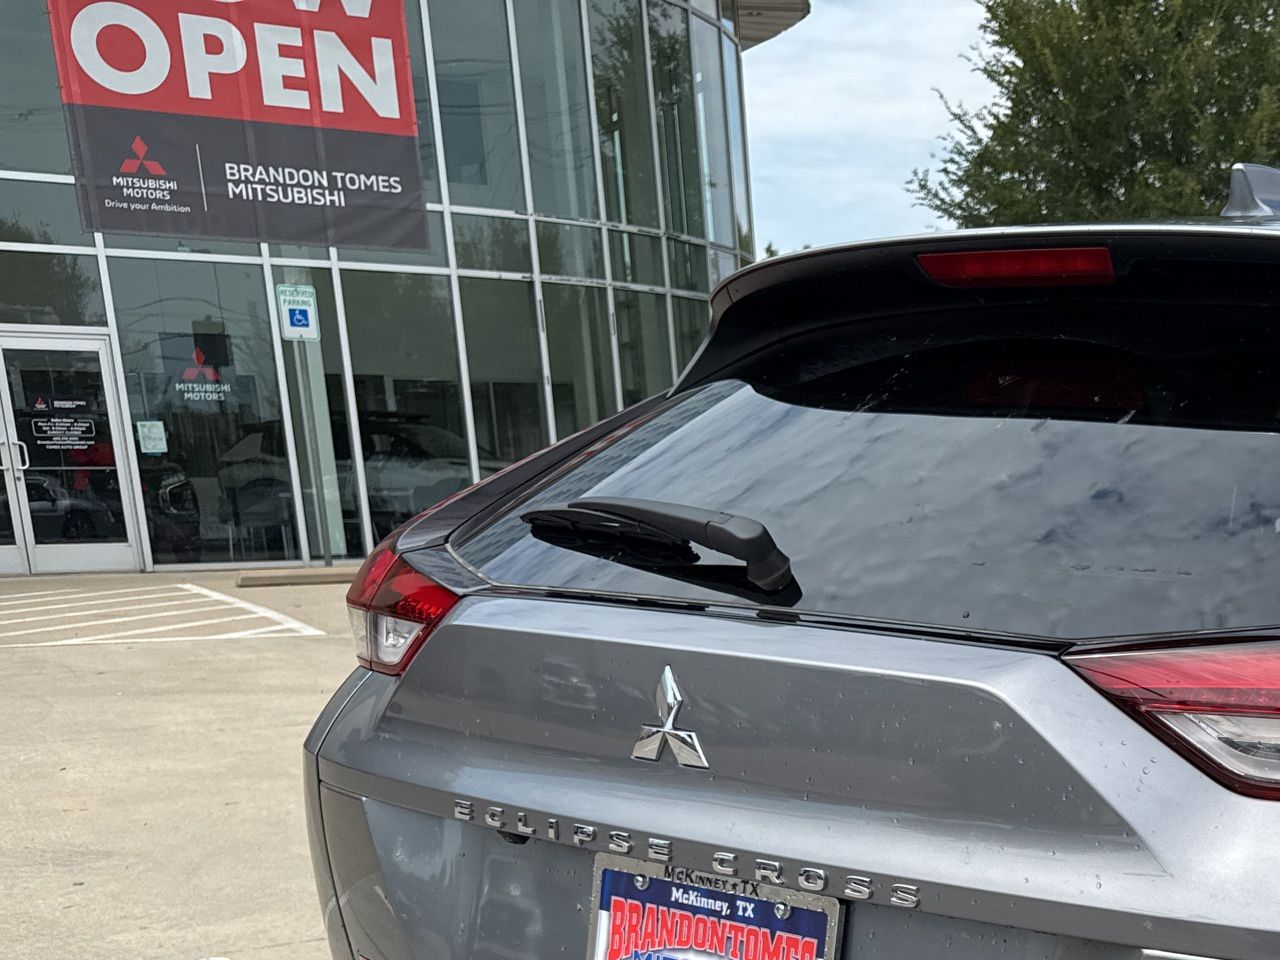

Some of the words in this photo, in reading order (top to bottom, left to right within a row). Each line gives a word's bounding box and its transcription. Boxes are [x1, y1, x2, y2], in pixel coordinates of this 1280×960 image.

[71, 1, 400, 119] OPEN
[112, 176, 178, 190] MITSUBISHI
[225, 163, 329, 187] BRANDON
[332, 172, 402, 193] TOMES
[123, 187, 171, 200] MOTORS
[227, 182, 346, 207] MITSUBISHI
[104, 199, 128, 209] Drive
[129, 202, 149, 211] your
[151, 202, 191, 213] Ambition
[175, 383, 232, 392] MITSUBISHI
[184, 392, 225, 401] MOTORS
[454, 799, 673, 862] ECLIPSE
[712, 852, 921, 908] CROSS
[741, 879, 759, 897] TX
[671, 886, 731, 916] McKinney,
[736, 900, 755, 918] TX
